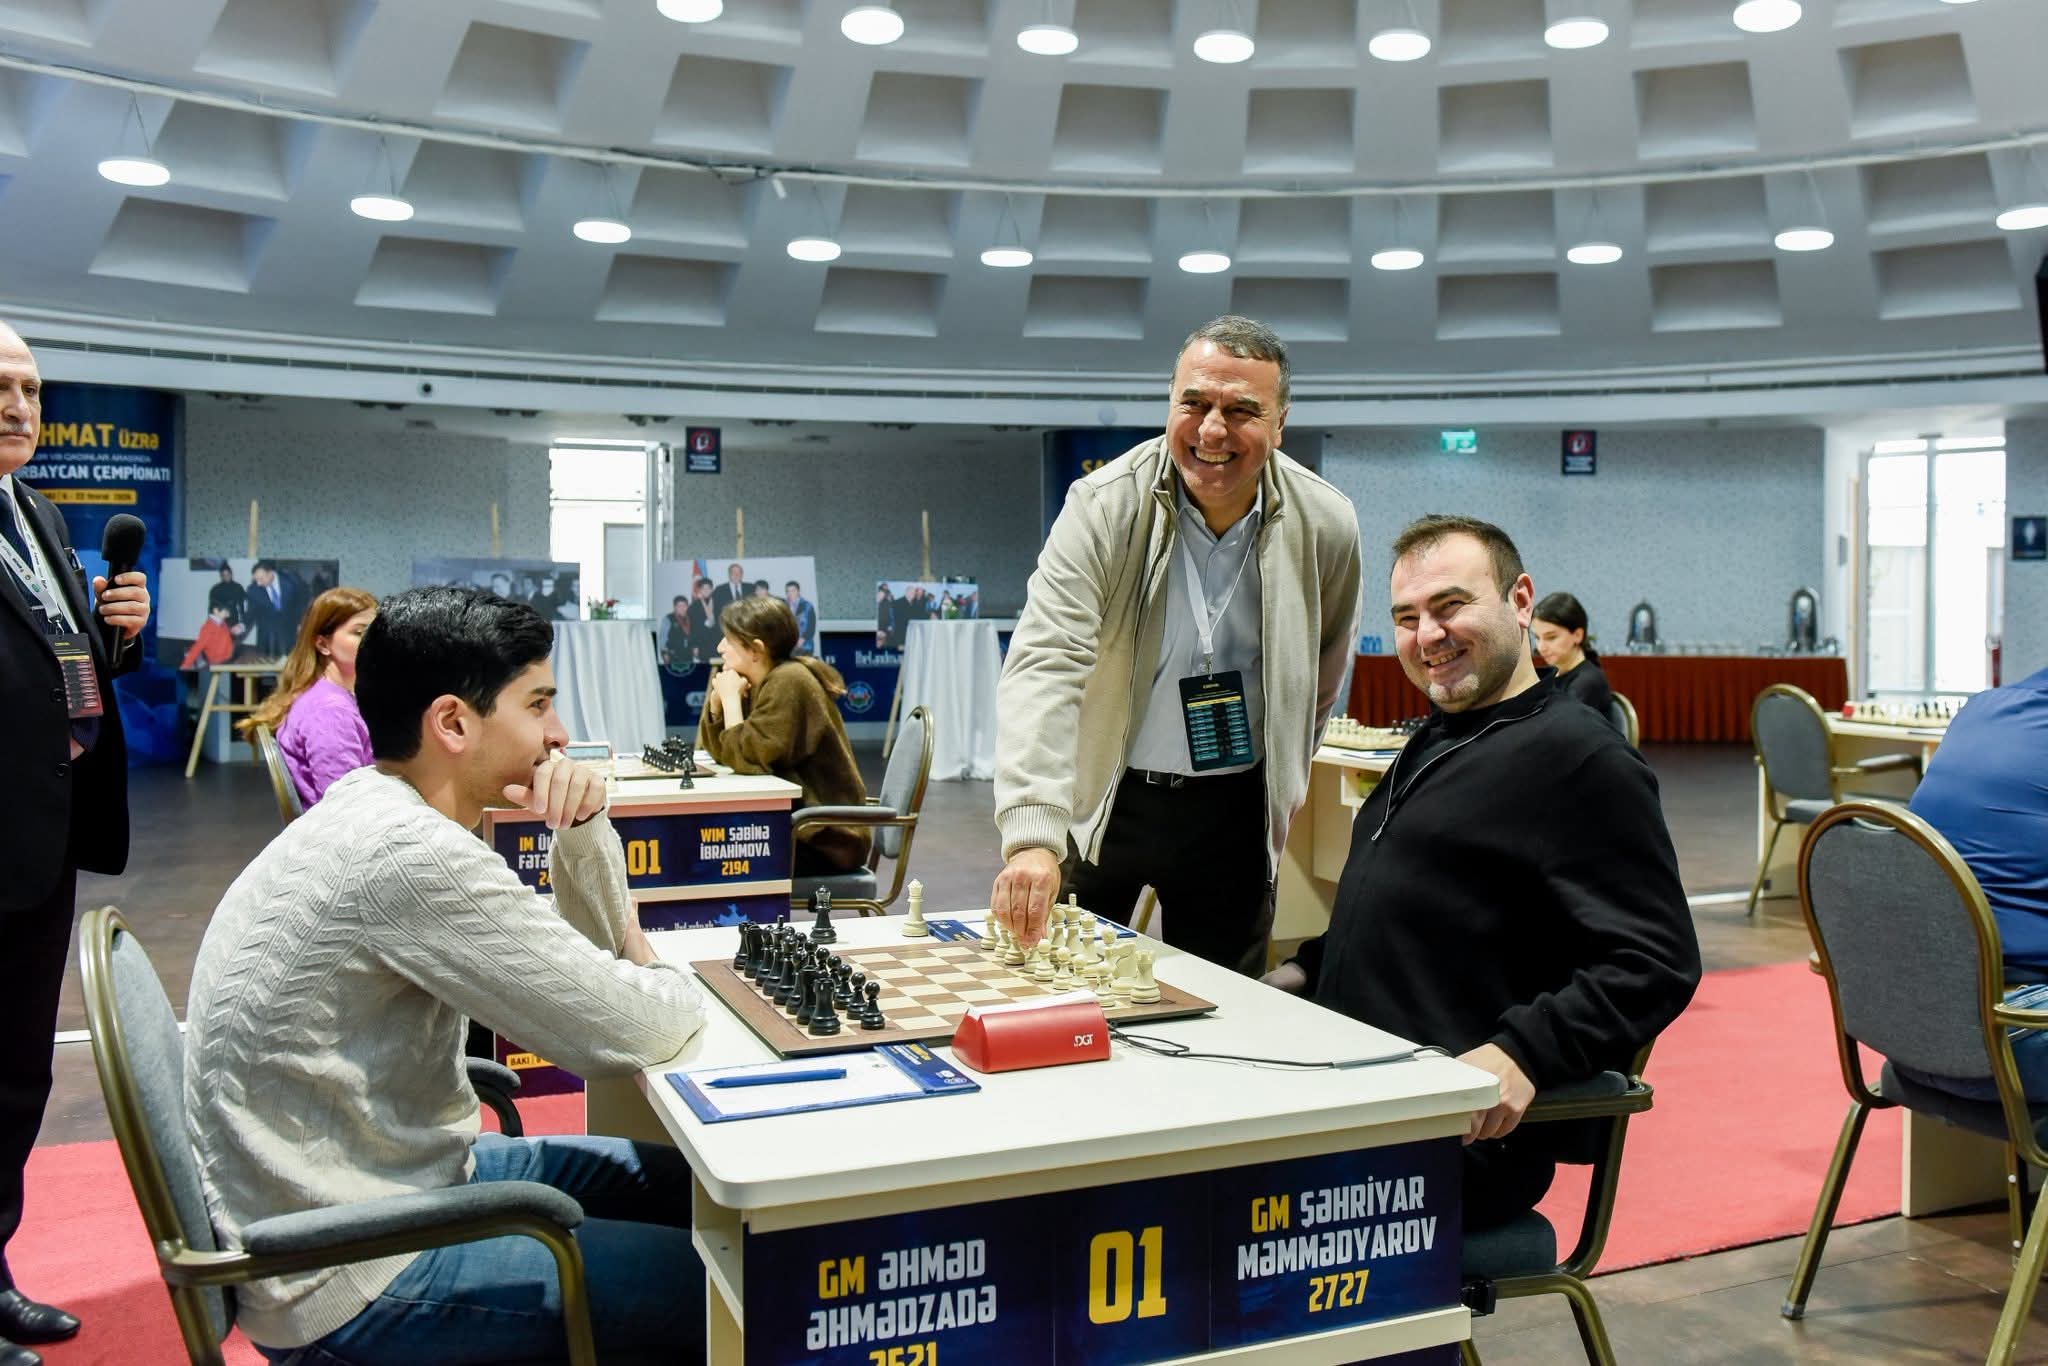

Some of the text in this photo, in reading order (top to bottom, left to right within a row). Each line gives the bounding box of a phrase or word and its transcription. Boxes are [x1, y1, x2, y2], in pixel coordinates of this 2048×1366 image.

[37, 423, 115, 448] HMAT
[519, 836, 534, 852] IM
[700, 828, 725, 843] WIM
[700, 841, 771, 861] İBRAHİMOVA
[627, 839, 661, 875] 01
[721, 860, 750, 876] 2194
[1073, 1033, 1094, 1047] DGT
[1251, 1175, 1425, 1233] GM ŞƏHRİYAR
[1237, 1216, 1437, 1281] MƏMMƏDYAROV
[818, 1239, 986, 1300] GM ƏHMƏD
[1088, 1225, 1167, 1325] 01
[1308, 1269, 1370, 1313] 2727
[806, 1285, 997, 1351] ƏHMƏDZADƏ
